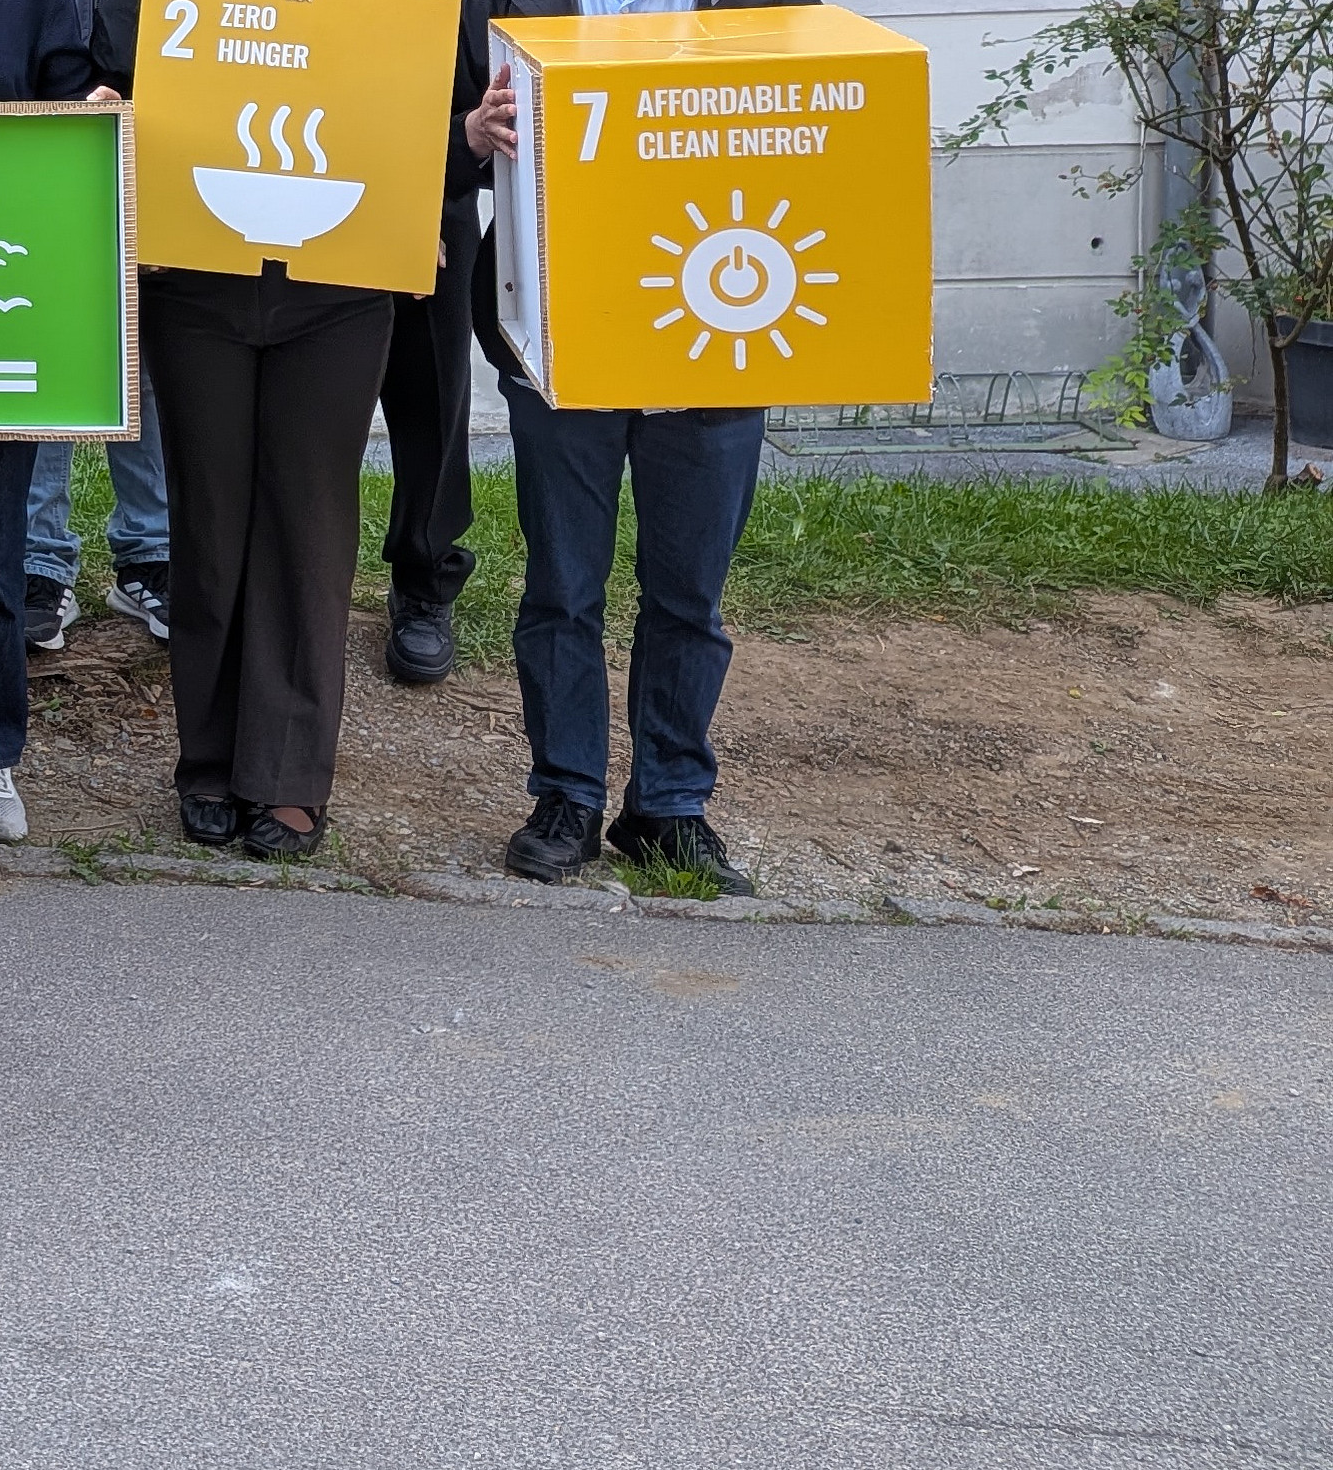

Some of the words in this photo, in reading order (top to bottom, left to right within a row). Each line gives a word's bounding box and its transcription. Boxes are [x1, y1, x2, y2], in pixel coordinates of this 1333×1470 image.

[219, 2, 277, 31] ZERO
[216, 37, 310, 70] HUNGER
[636, 84, 803, 118] AFFORDABLE
[809, 81, 865, 112] AND
[572, 91, 609, 162] 7
[637, 129, 719, 160] CLEAN
[726, 125, 830, 157] ENERGY
